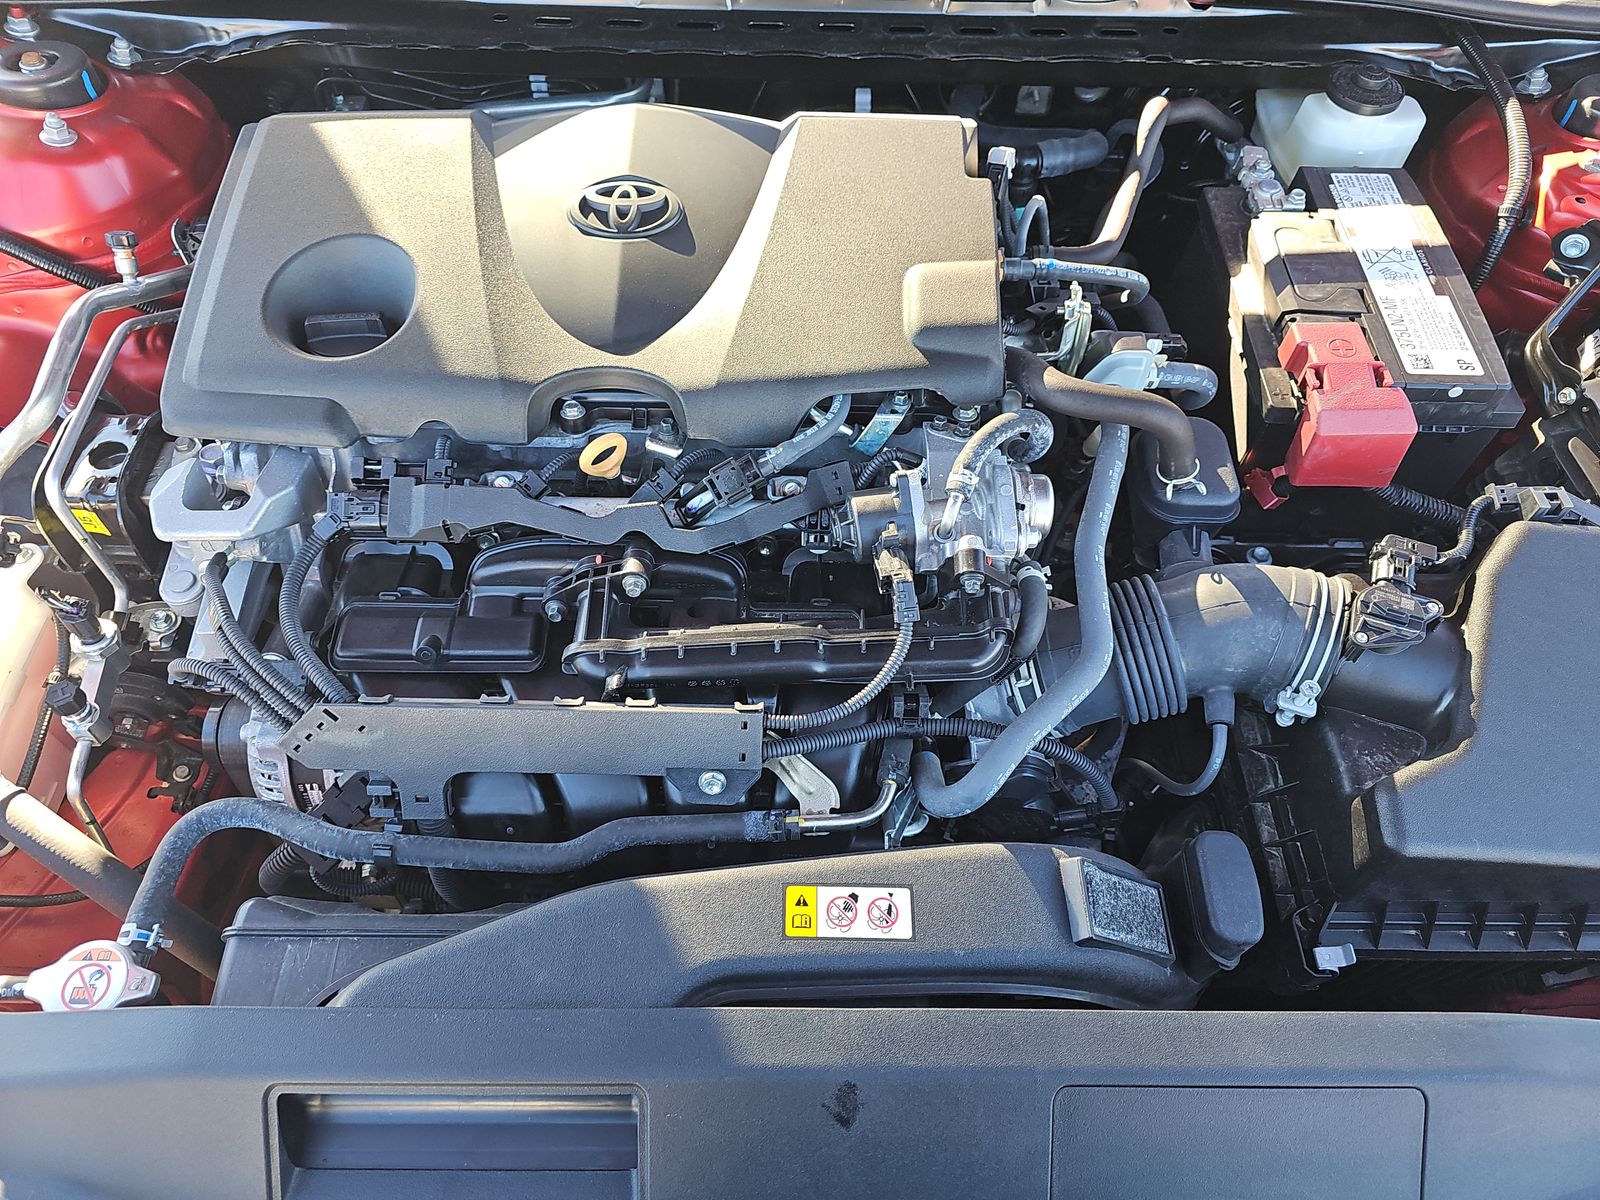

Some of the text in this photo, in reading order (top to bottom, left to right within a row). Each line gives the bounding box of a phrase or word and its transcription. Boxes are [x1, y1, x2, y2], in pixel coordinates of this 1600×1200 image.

[1405, 250, 1416, 262] Pb
[1416, 249, 1435, 276] CLARIOS
[1380, 296, 1416, 350] 375LN2-MF
[1458, 359, 1476, 371] SP
